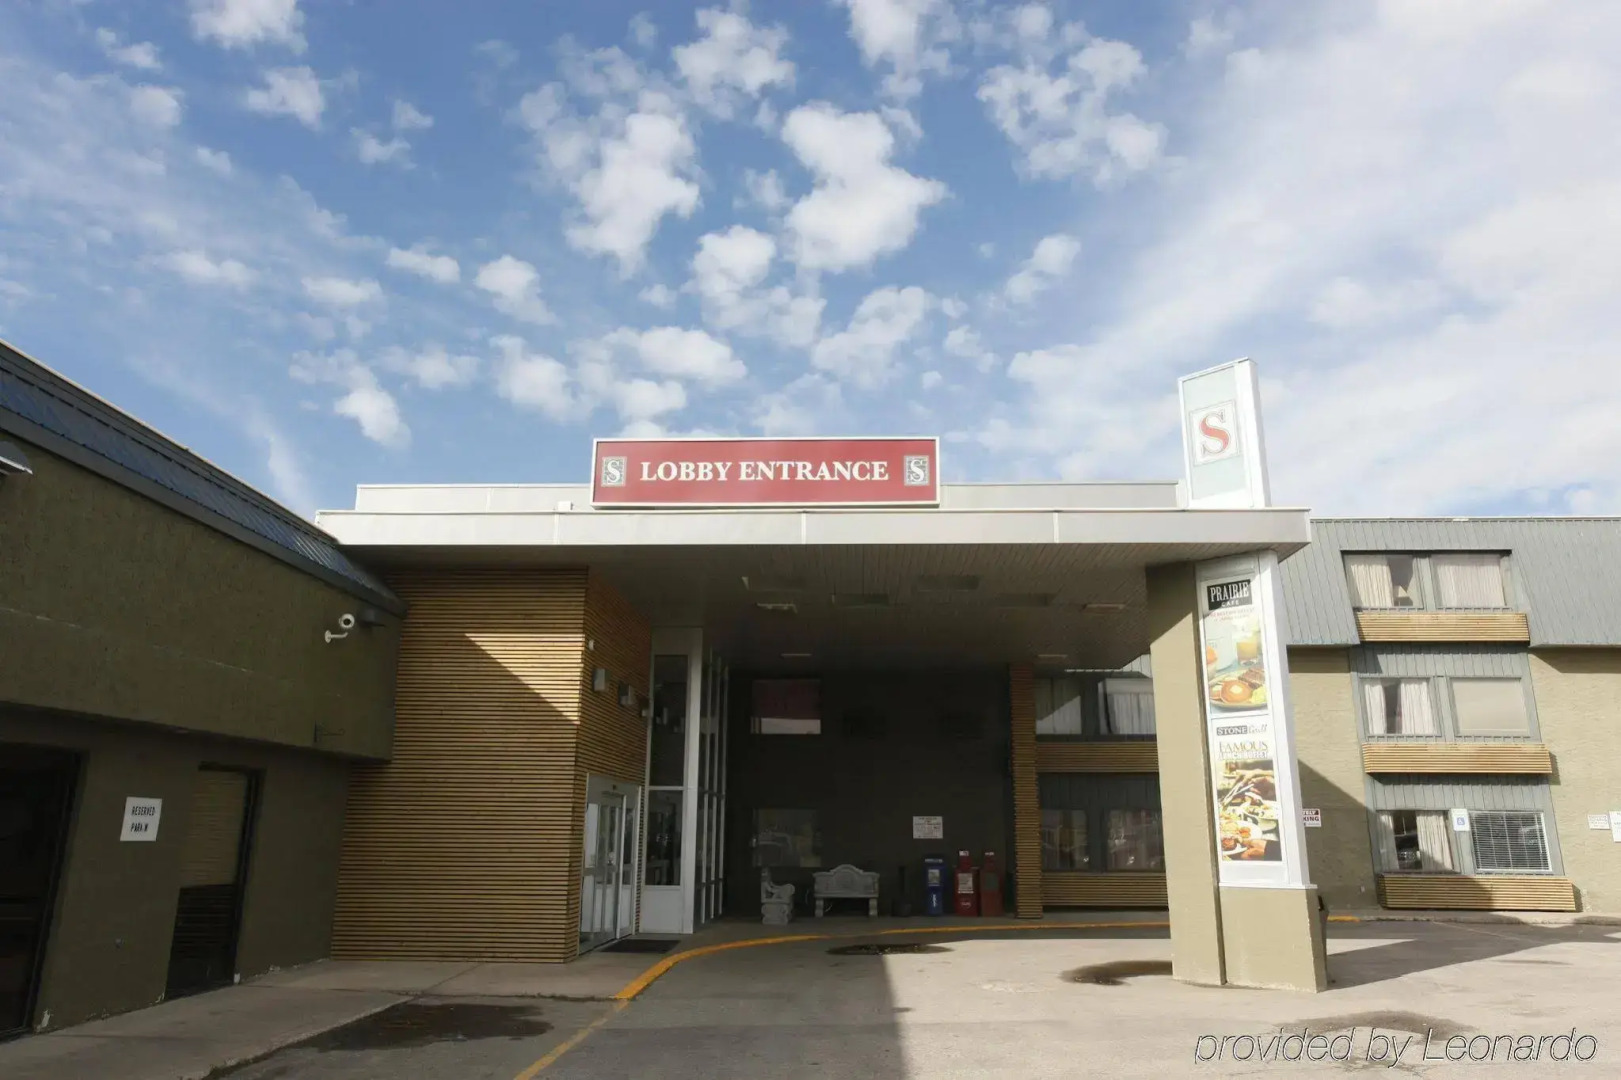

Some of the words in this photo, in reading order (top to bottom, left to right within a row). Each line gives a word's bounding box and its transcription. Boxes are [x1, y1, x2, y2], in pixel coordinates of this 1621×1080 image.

[1199, 408, 1231, 456] S
[640, 461, 732, 481] LOBBY
[738, 460, 889, 481] ENTRANCE
[1210, 582, 1249, 602] PRAIRIE
[1217, 725, 1247, 735] STONE
[1219, 741, 1268, 752] FAMOUS
[131, 806, 156, 816] RESERVED
